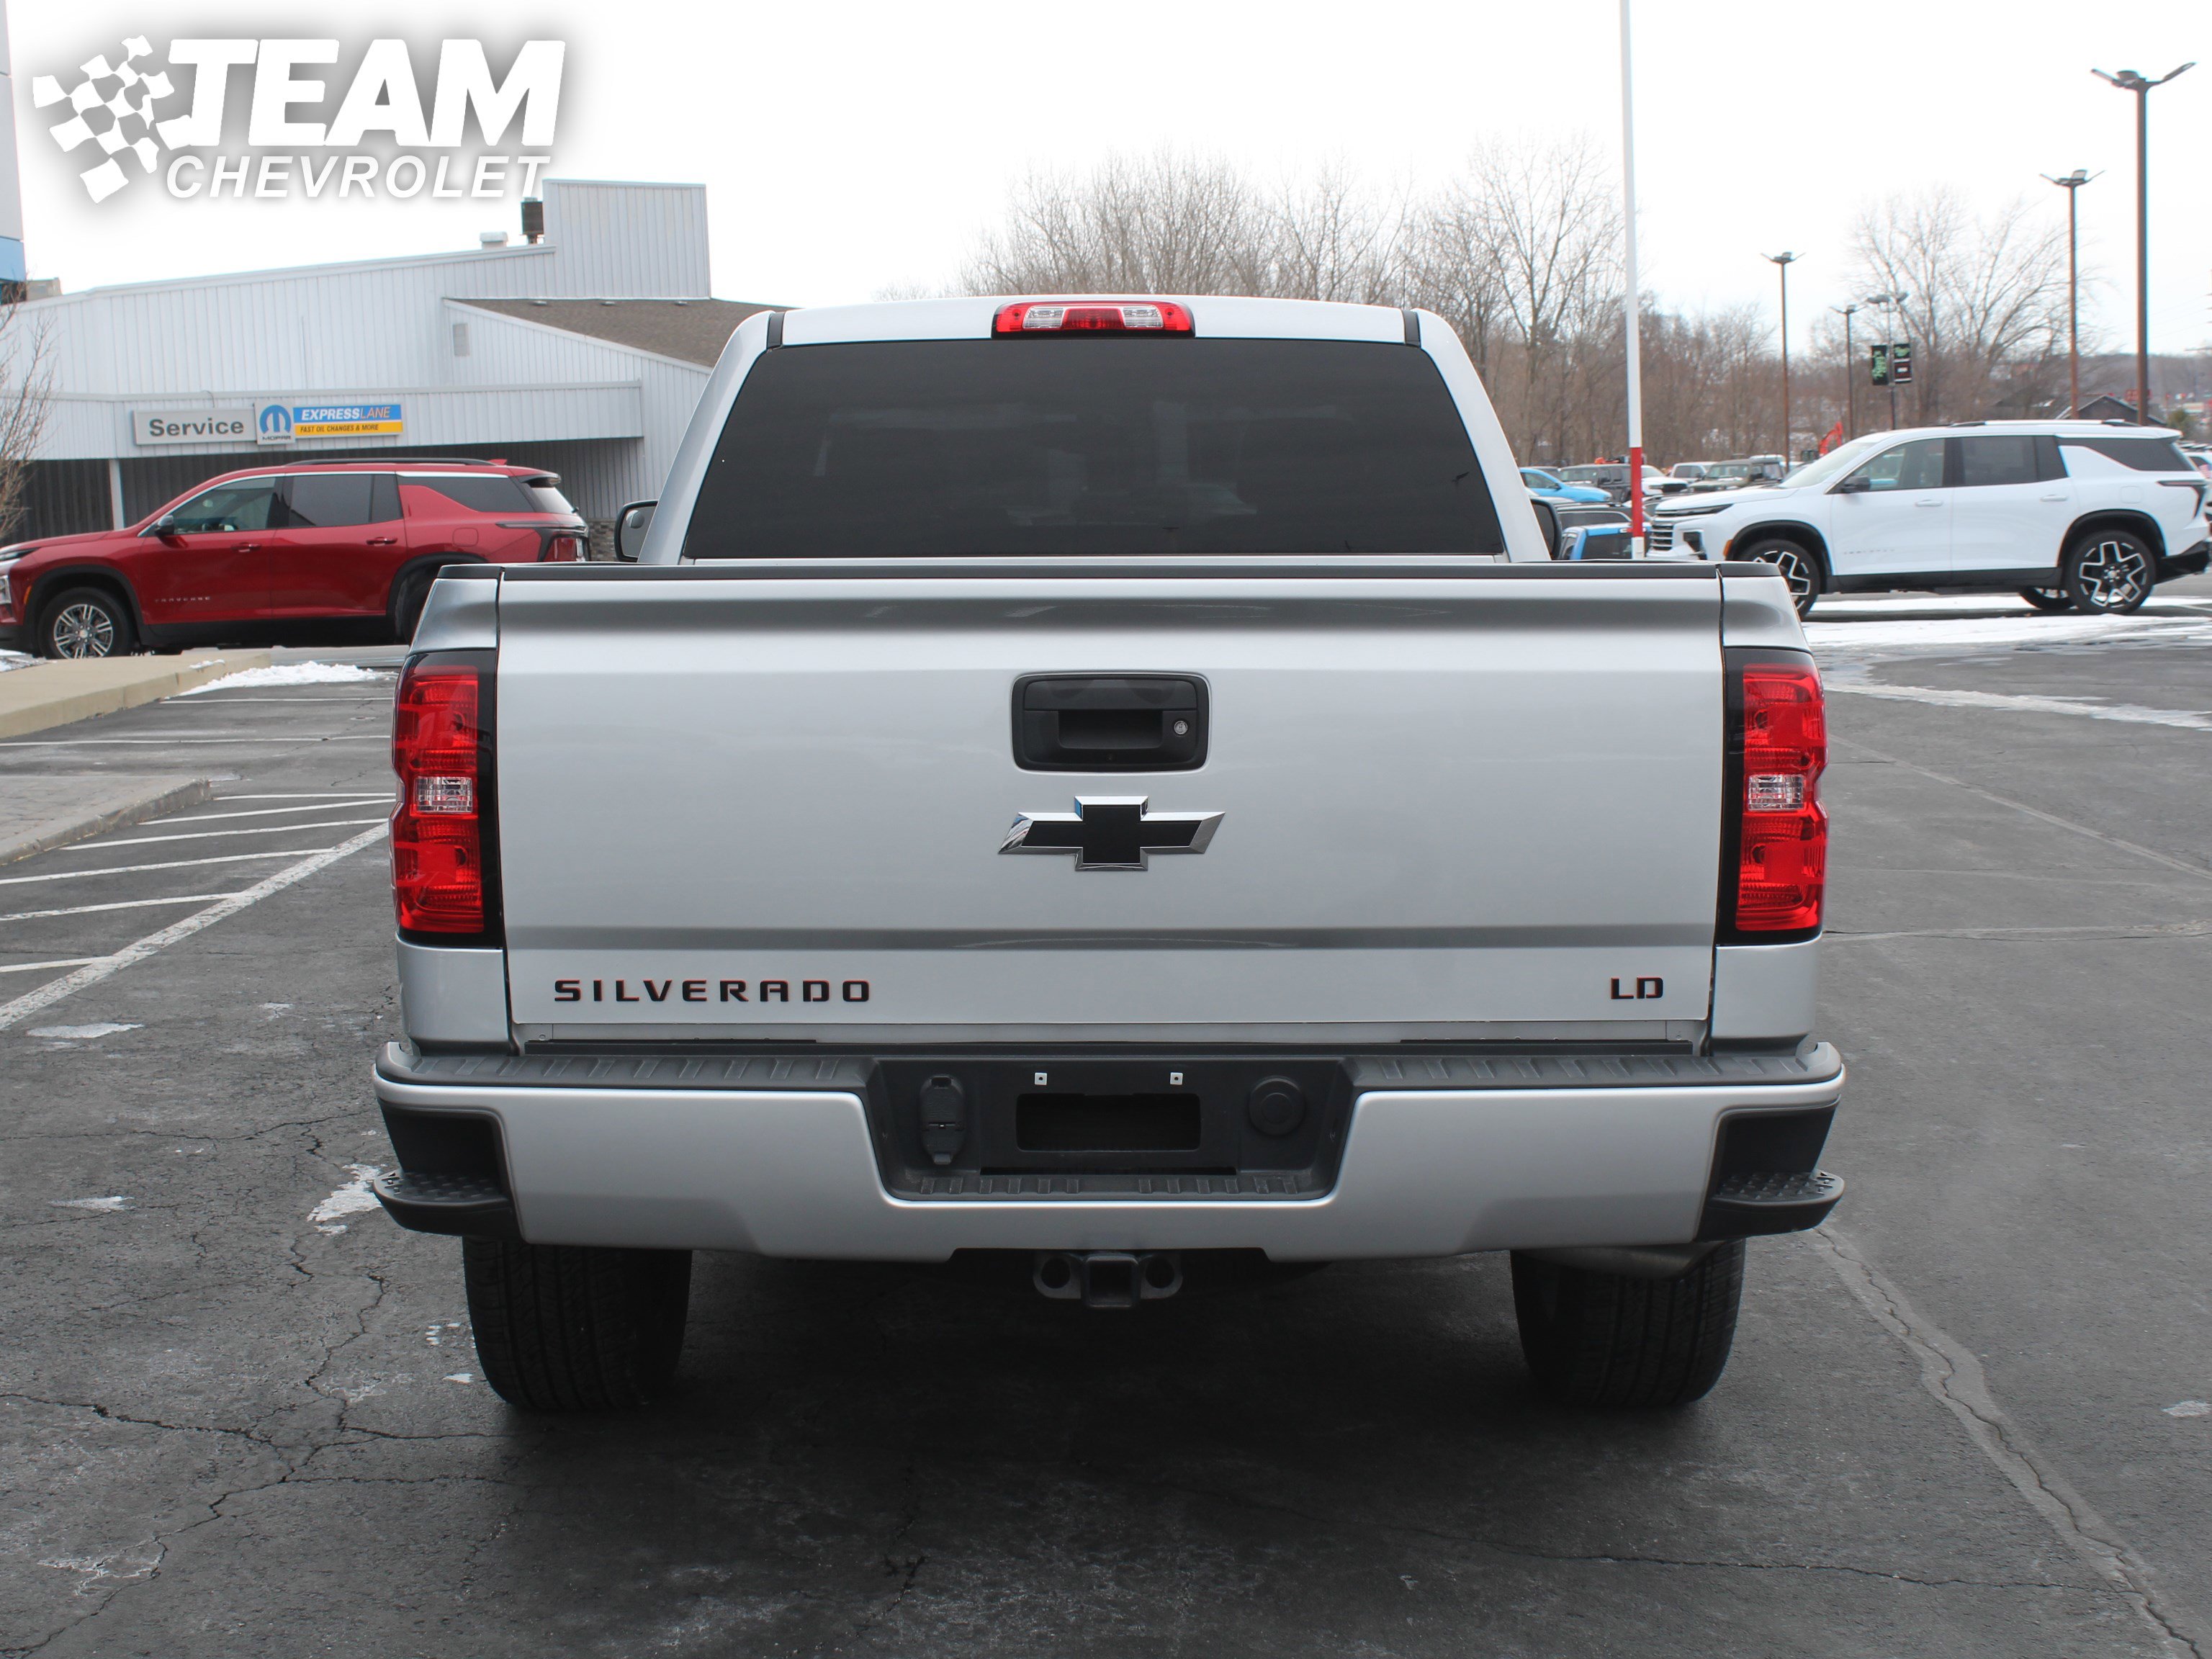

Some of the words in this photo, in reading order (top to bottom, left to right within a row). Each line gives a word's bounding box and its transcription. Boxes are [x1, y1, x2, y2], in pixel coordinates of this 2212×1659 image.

[149, 417, 244, 437] Service
[554, 979, 871, 1003] SILVERADO
[1610, 976, 1664, 999] LD
